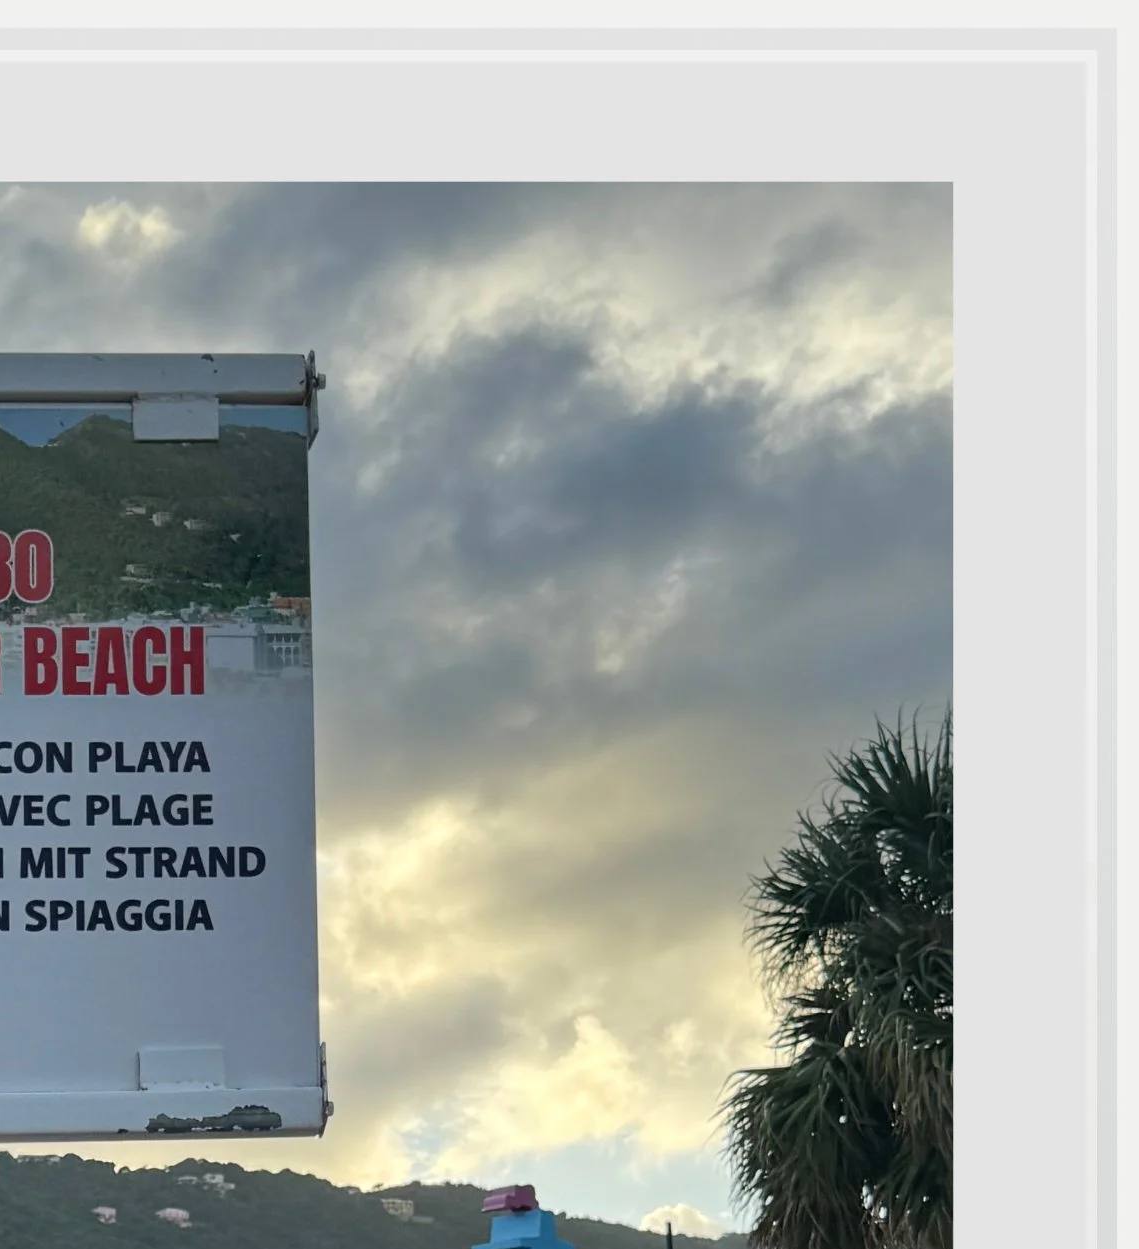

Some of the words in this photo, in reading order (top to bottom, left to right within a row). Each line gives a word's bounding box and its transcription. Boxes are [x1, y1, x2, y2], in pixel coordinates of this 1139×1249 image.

[23, 626, 205, 697] BEACH
[87, 739, 212, 775] PLAYA
[84, 792, 215, 828] PLAGE
[18, 845, 93, 880] MIT
[104, 844, 268, 880] STRAND
[23, 897, 216, 934] SPIAGGIA
